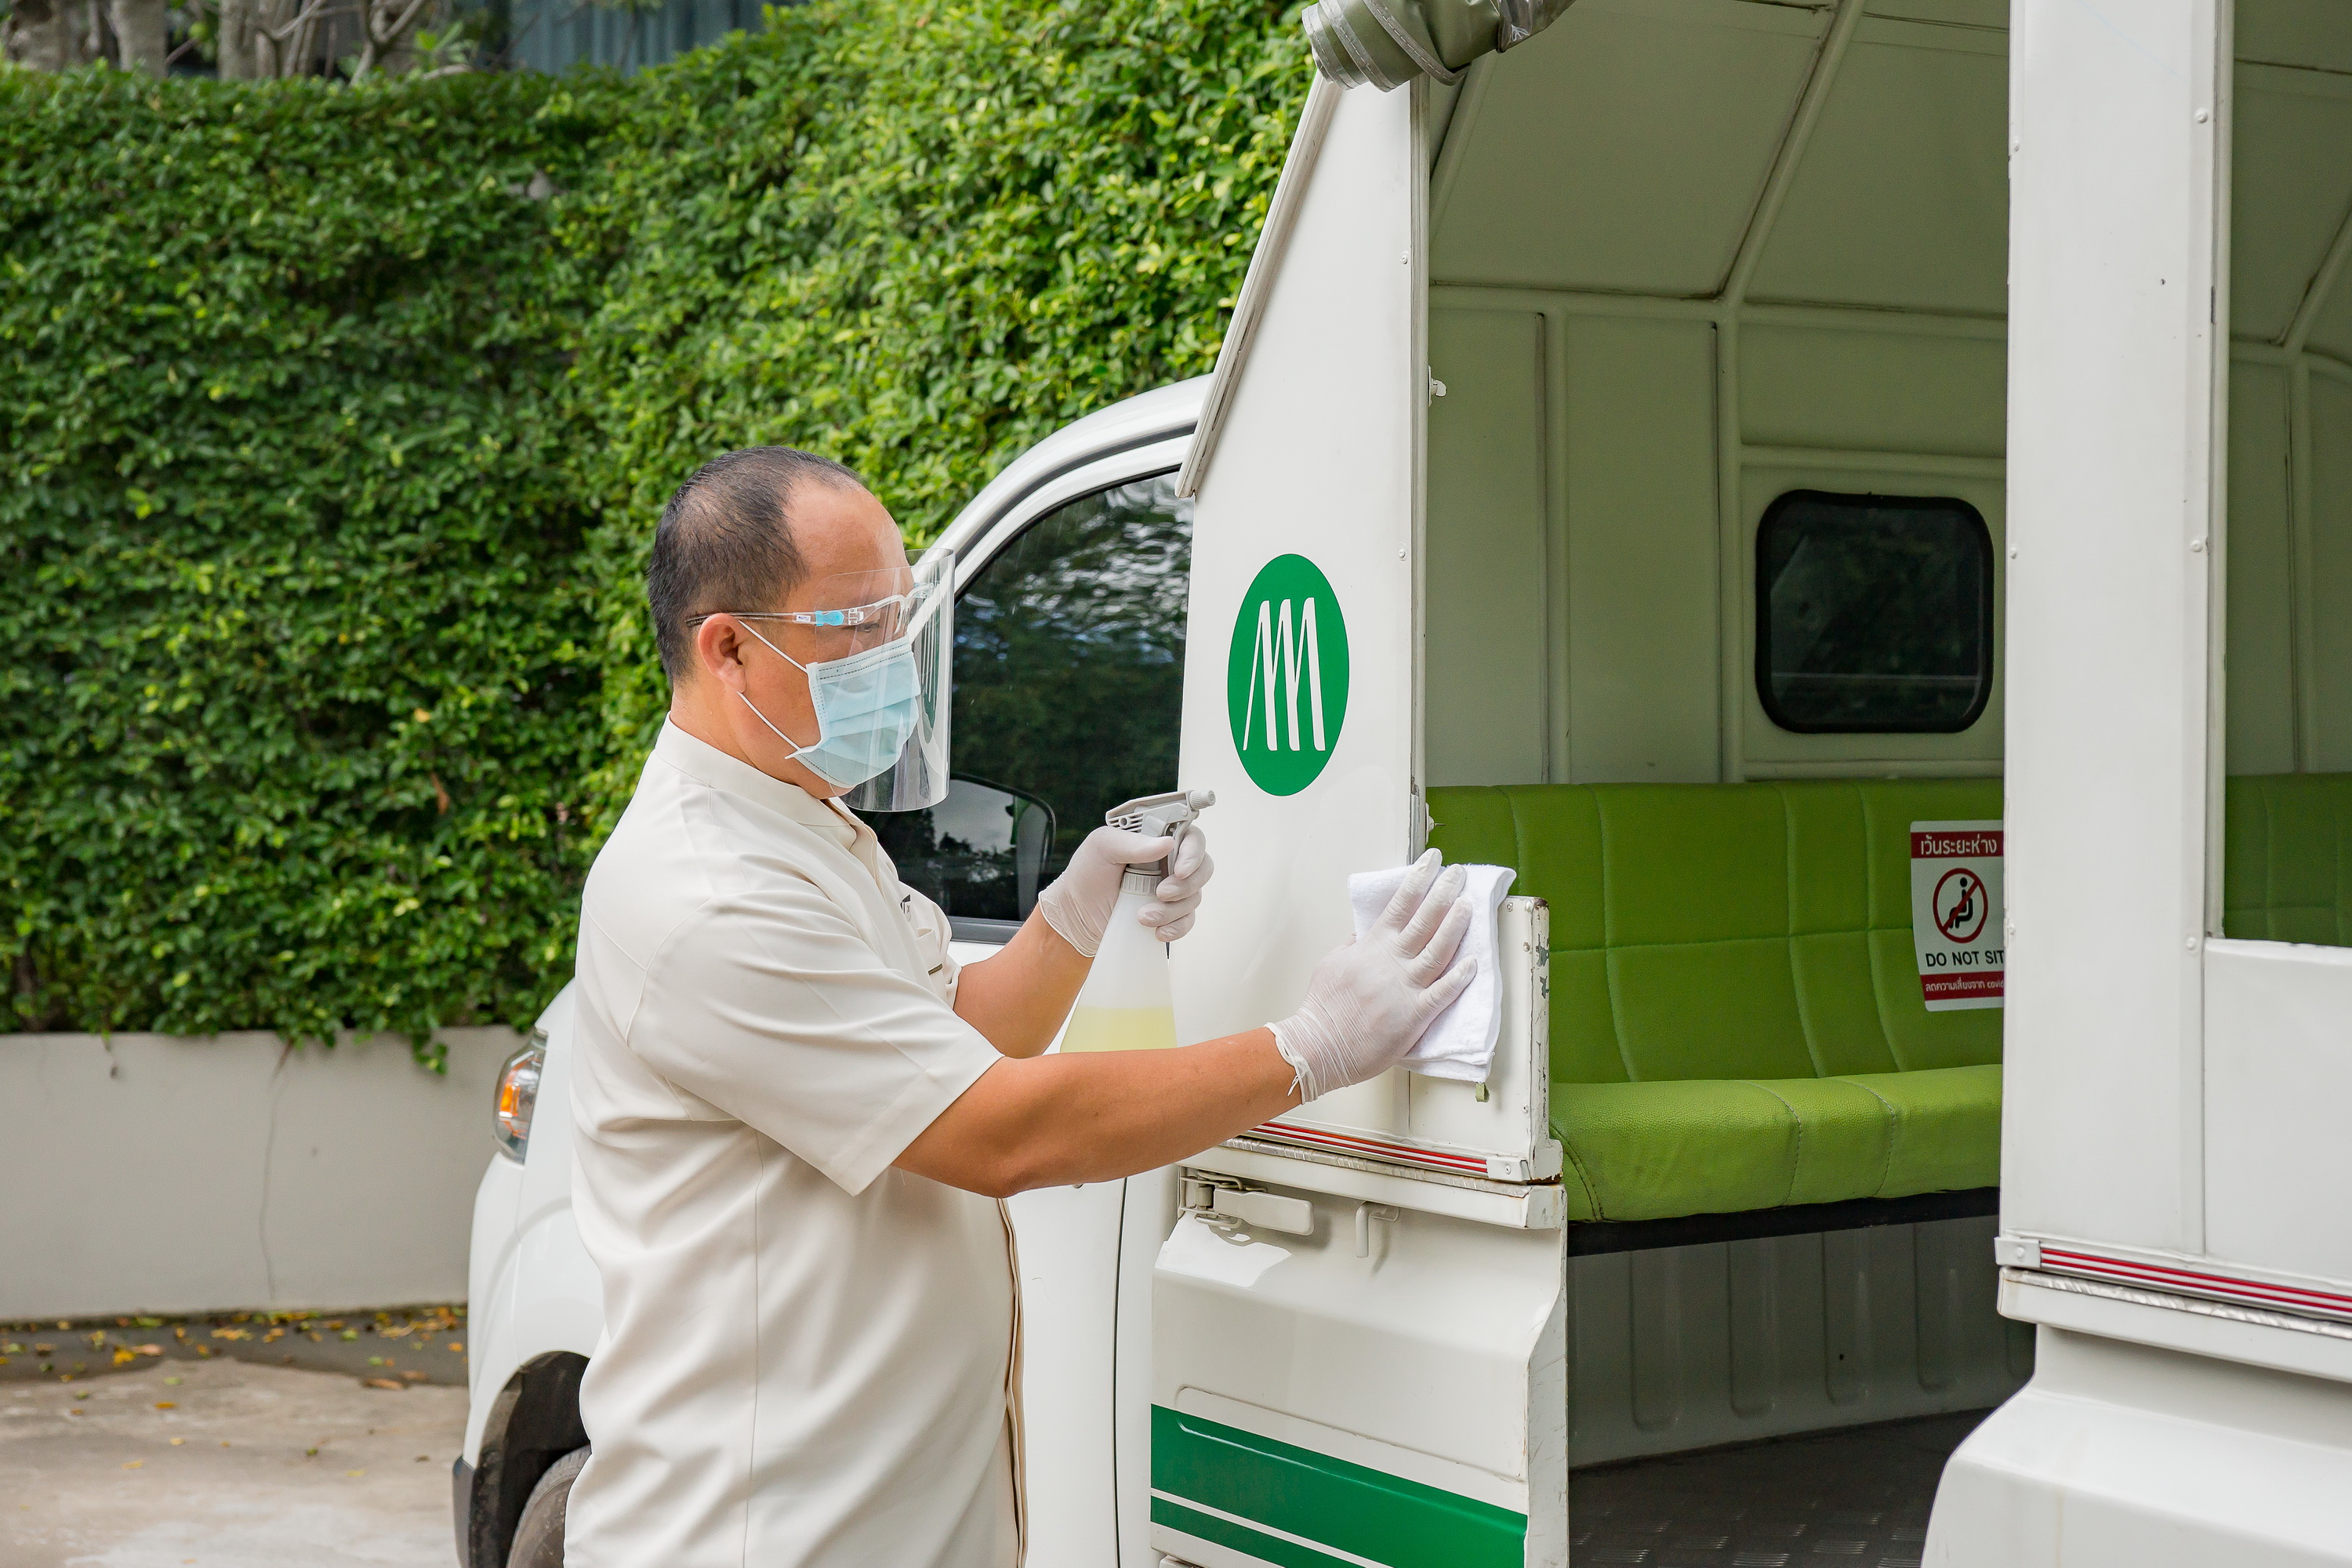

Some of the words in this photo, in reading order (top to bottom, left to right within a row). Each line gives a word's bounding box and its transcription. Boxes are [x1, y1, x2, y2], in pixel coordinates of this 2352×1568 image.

[1921, 833, 1997, 855] เว้นระยะห่าง
[1926, 953, 1947, 967] DO
[1951, 951, 1979, 965] NOT
[1984, 949, 2004, 964] SIT
[1926, 977, 1985, 992] ลดความเสี่ยงจาก
